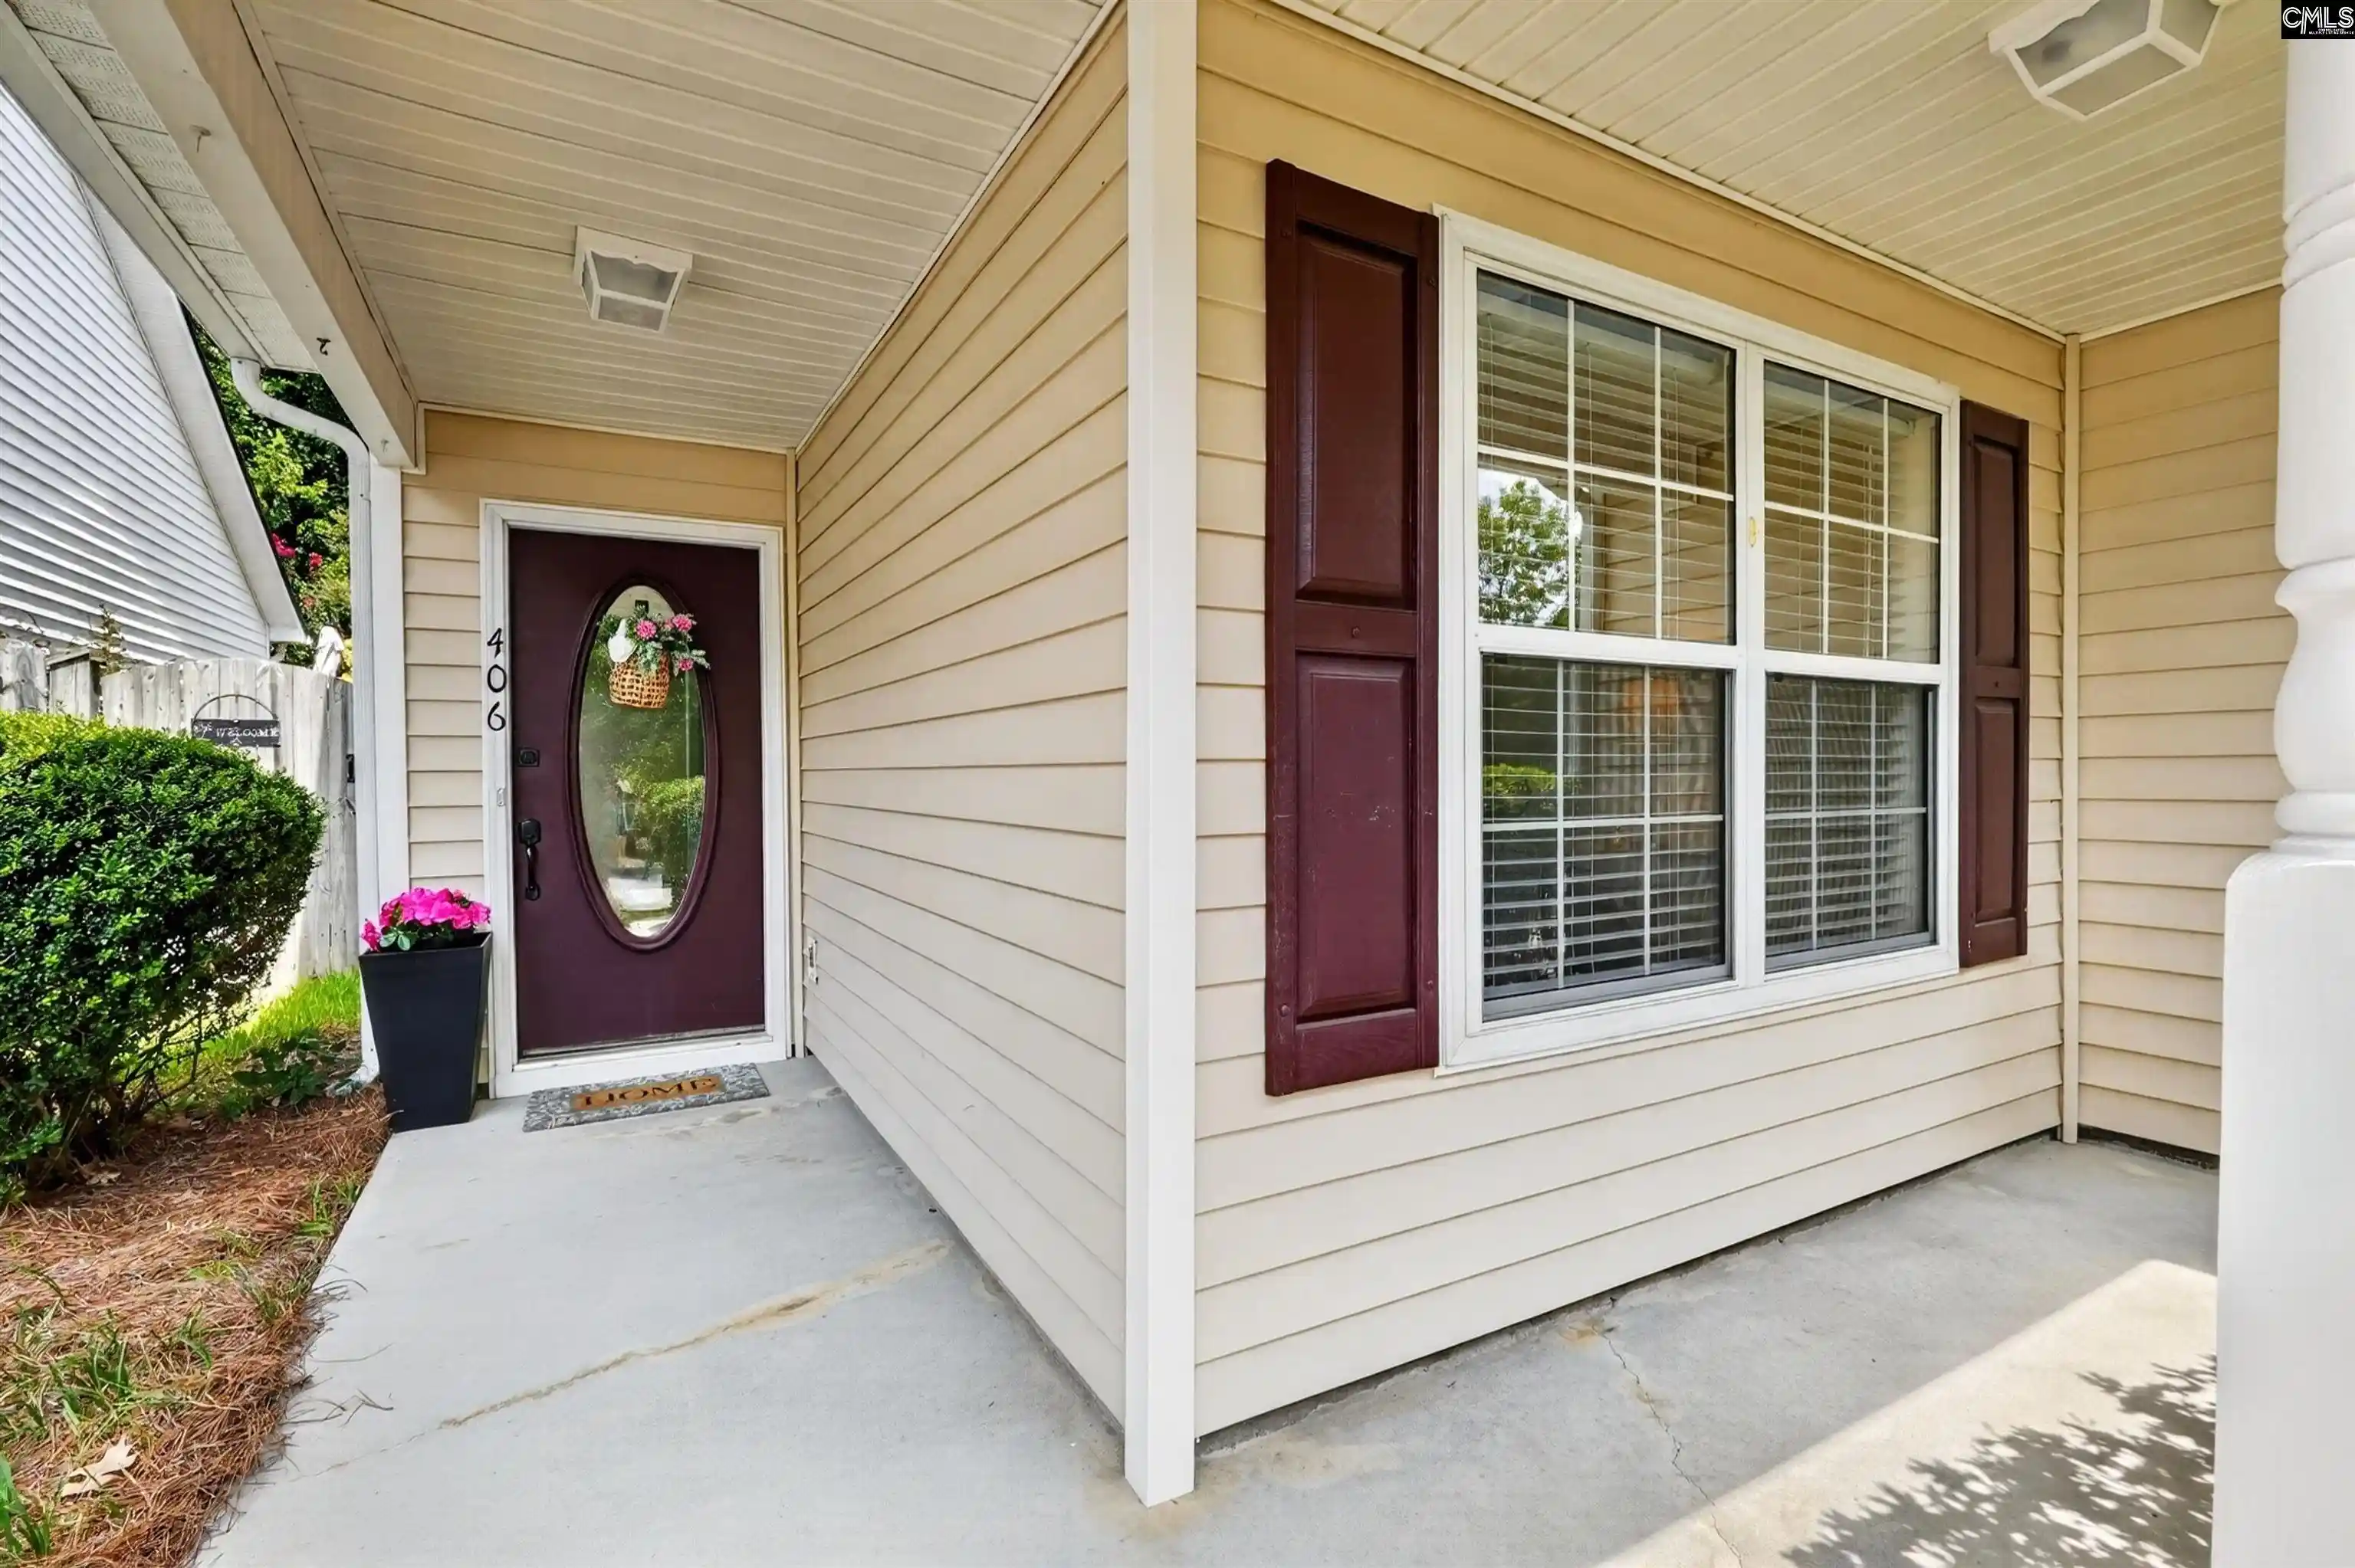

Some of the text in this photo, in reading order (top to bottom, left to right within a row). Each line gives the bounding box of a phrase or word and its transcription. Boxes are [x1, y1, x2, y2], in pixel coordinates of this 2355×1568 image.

[487, 628, 507, 732] 406
[216, 727, 279, 738] WELCOME
[584, 1078, 718, 1106] HOME
